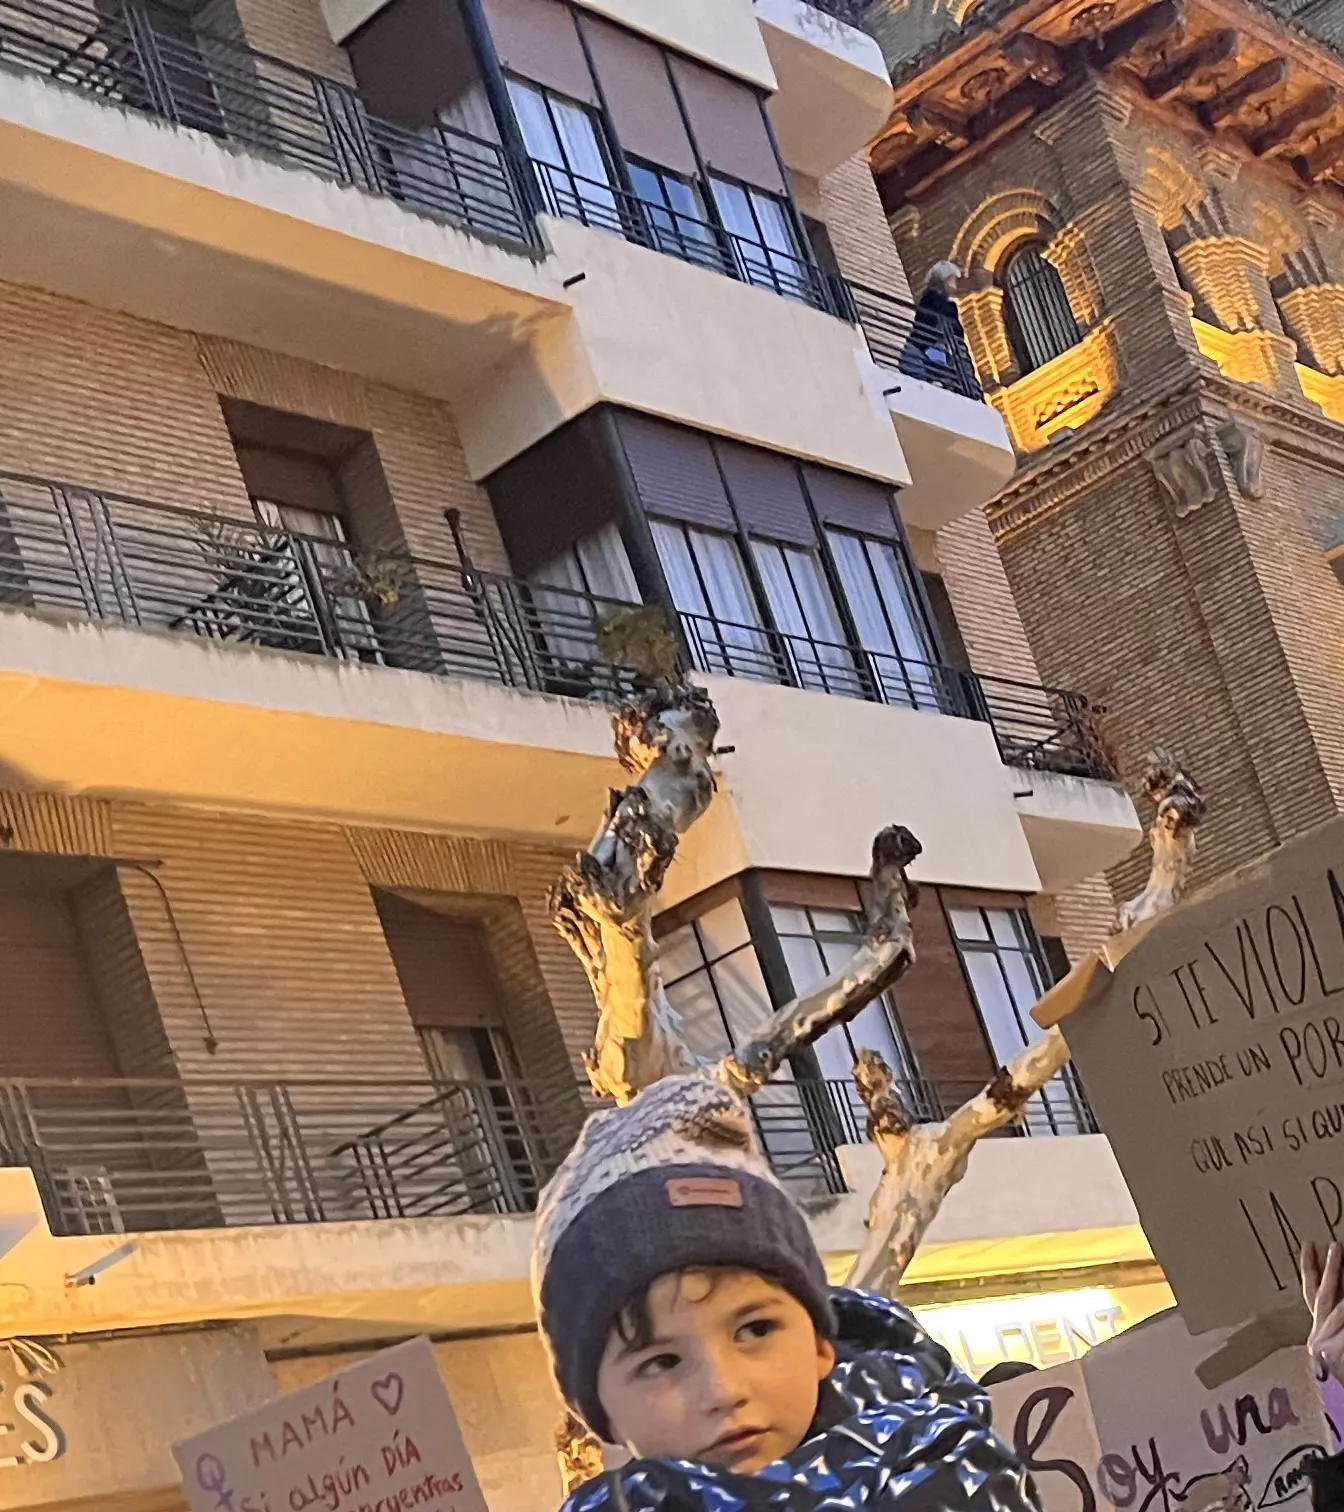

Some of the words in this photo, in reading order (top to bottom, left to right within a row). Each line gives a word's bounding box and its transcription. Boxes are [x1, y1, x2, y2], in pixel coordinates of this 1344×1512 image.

[1133, 984, 1172, 1046] SI
[1169, 960, 1219, 1029] TE
[1162, 1054, 1234, 1103] PRENDE
[1238, 1043, 1271, 1077] UN
[1191, 1136, 1232, 1173] QUE
[1234, 1125, 1274, 1164] ASI
[1282, 1117, 1308, 1151] SI
[1239, 1190, 1303, 1291] LA
[250, 1380, 354, 1468] MAMÁ
[1200, 1387, 1301, 1454] una
[289, 1455, 370, 1511] algún
